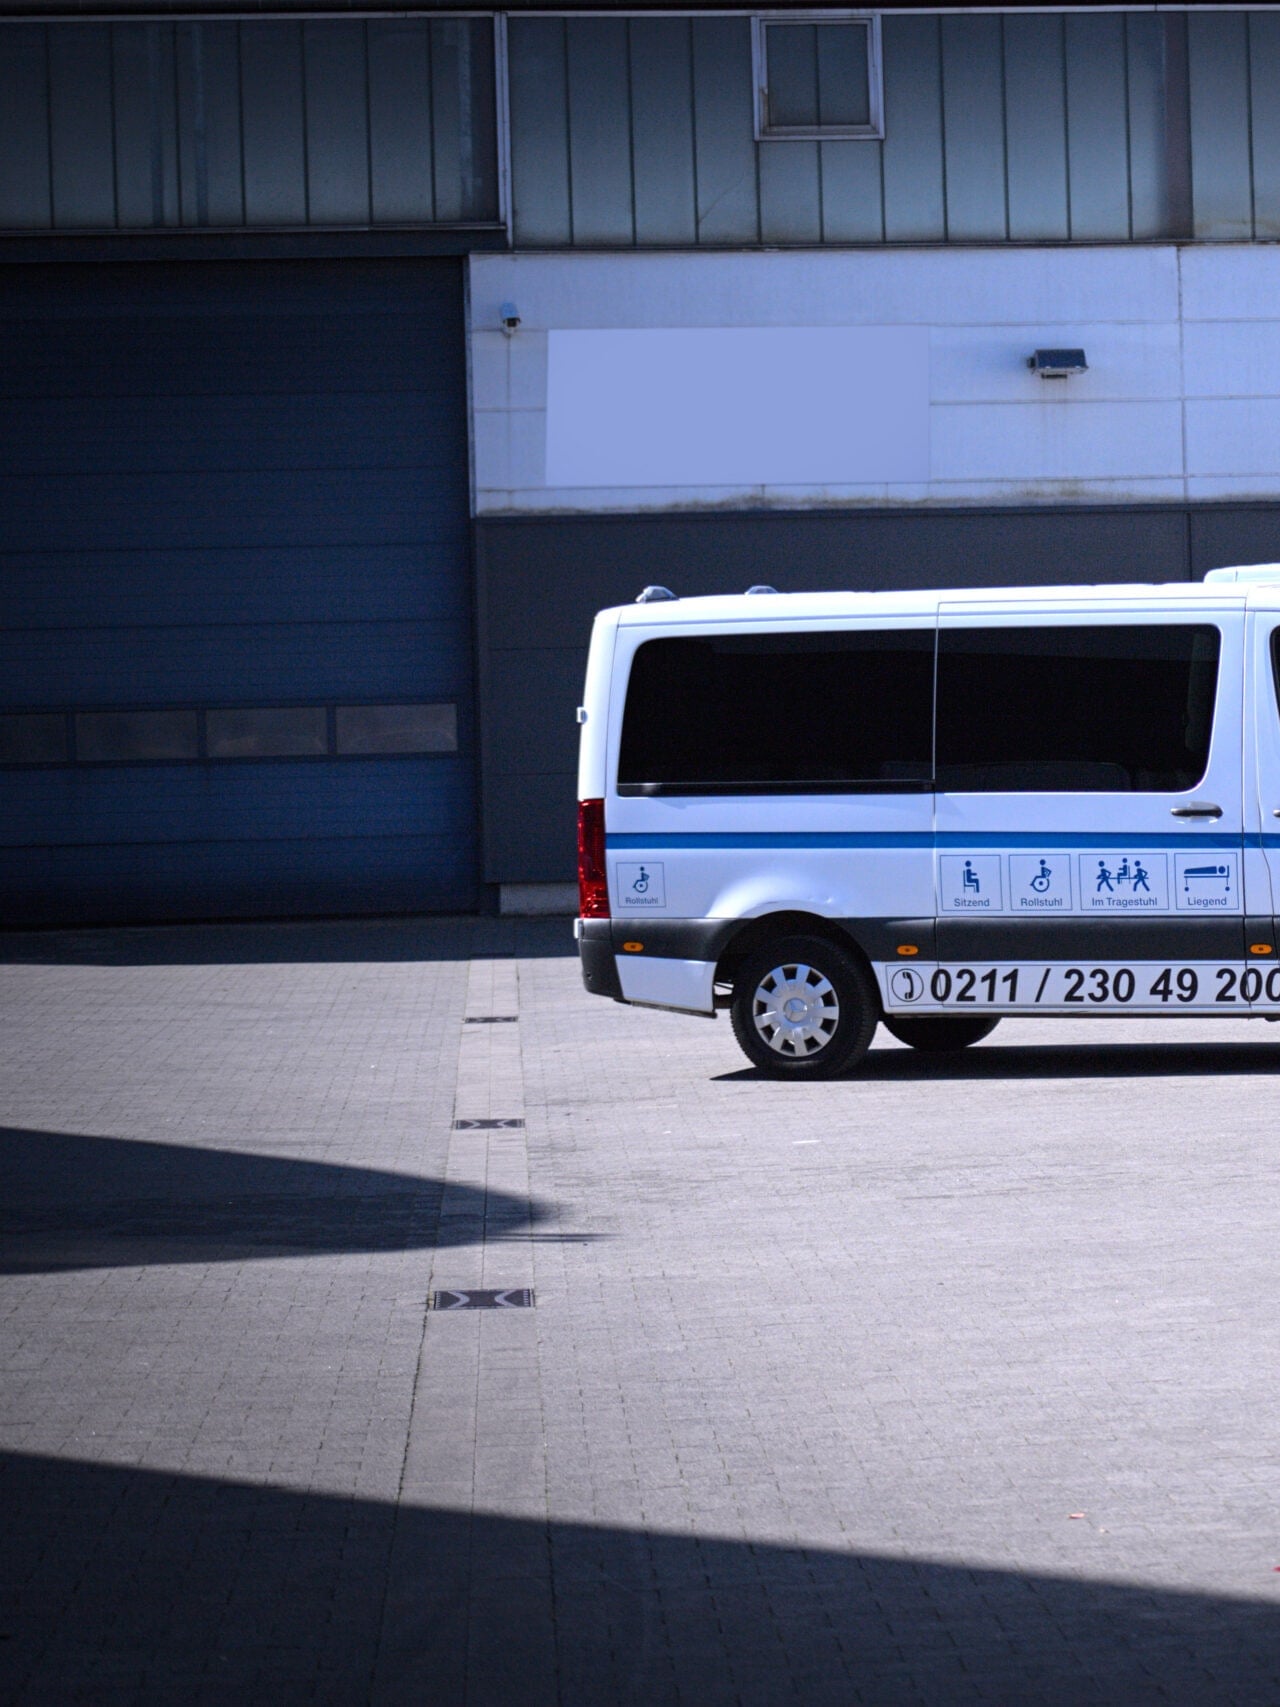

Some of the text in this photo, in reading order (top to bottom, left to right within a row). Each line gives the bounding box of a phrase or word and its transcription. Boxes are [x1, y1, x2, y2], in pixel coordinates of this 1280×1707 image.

[625, 896, 659, 905] Rollstuhl
[953, 897, 990, 908] Sitzend
[1020, 897, 1064, 908] Rollstuhl
[1091, 896, 1158, 909] Im Tragestuhl
[1187, 896, 1227, 909] Liegend
[930, 967, 1020, 1003] 0211
[1034, 967, 1052, 1003] /
[1063, 967, 1136, 1003] 230
[1149, 967, 1199, 1003] 49
